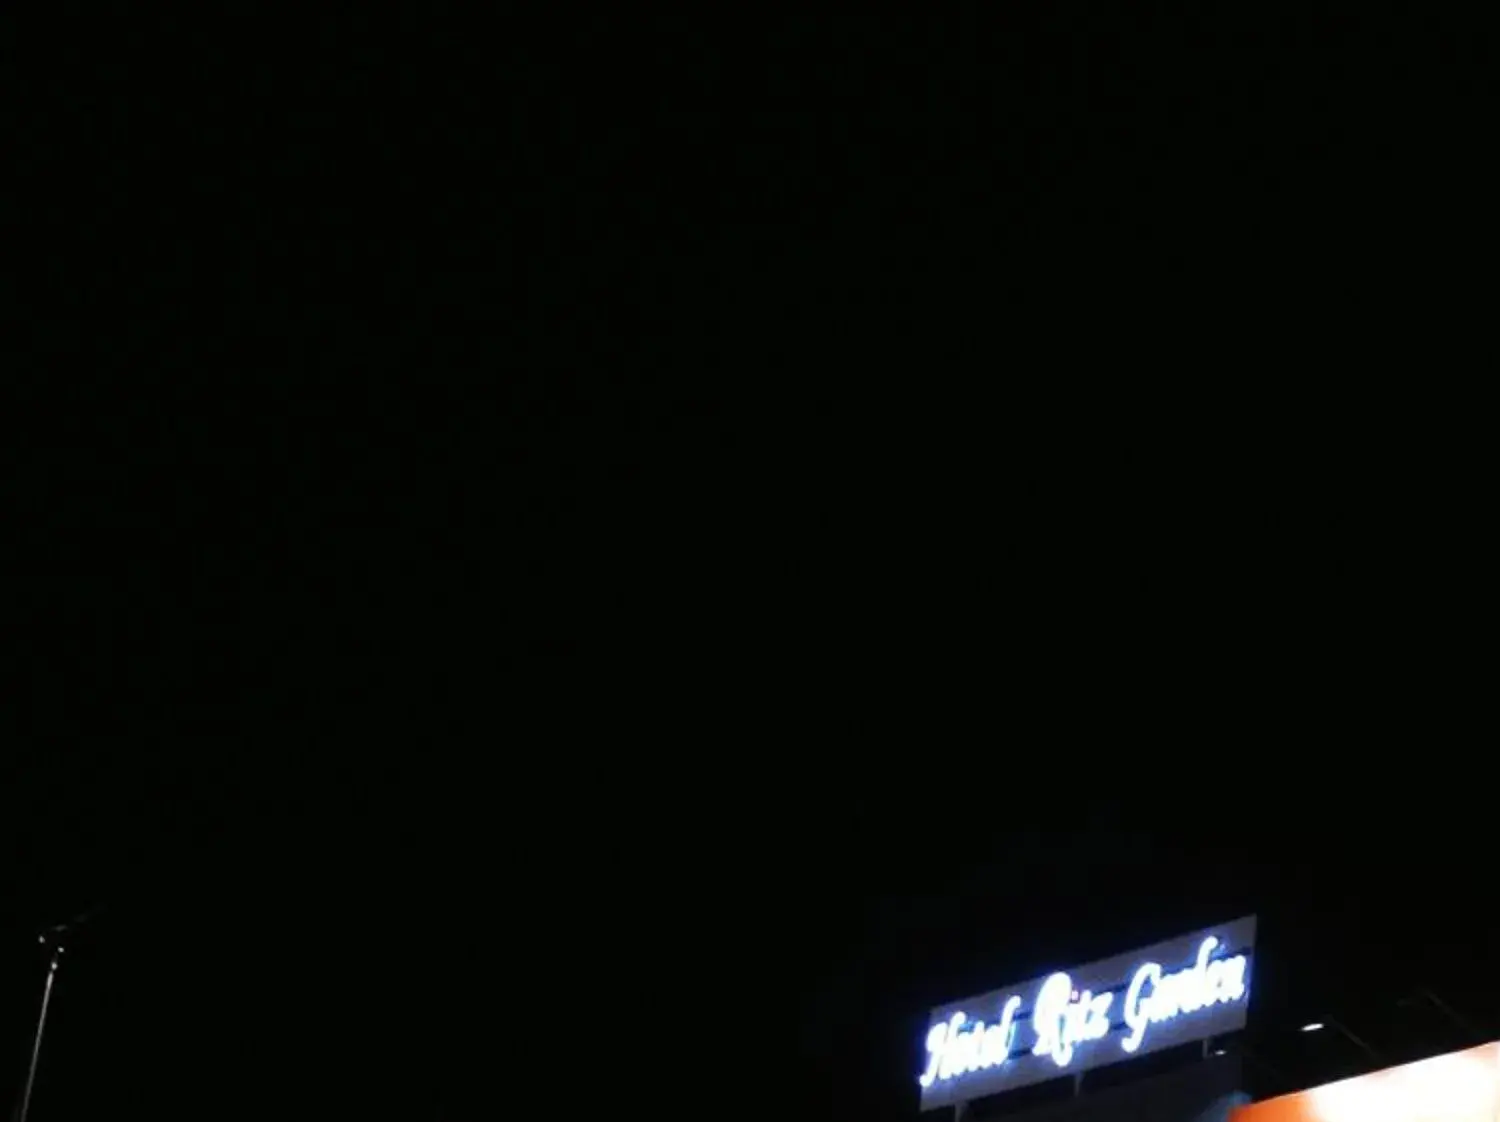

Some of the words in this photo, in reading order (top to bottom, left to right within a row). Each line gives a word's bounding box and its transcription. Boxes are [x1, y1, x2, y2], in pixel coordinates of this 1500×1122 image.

[919, 995, 1021, 1087] Hotel
[1033, 971, 1113, 1067] Ritz
[1121, 935, 1247, 1052] Garden
